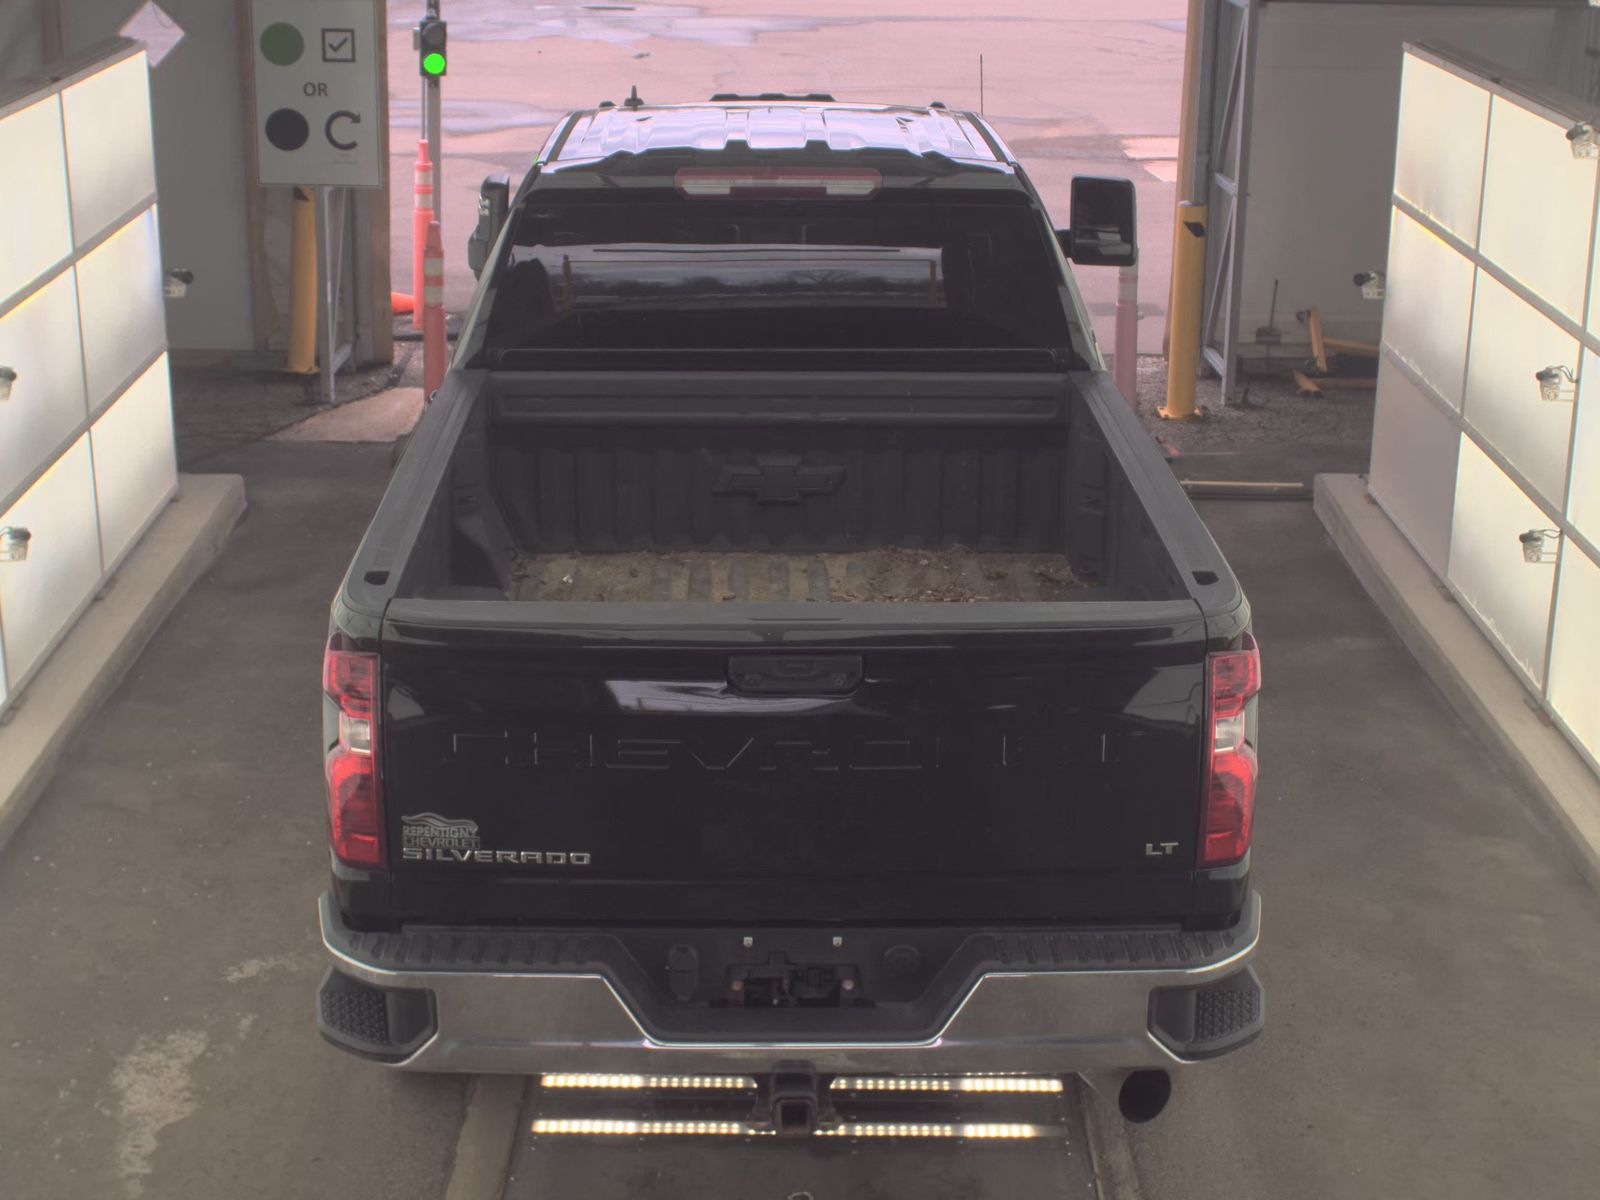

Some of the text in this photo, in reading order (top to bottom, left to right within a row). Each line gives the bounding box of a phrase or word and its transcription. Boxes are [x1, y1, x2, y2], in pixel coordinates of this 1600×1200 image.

[303, 82, 328, 97] OR
[440, 730, 1132, 770] CHEVRO
[402, 825, 479, 838] REPENTIGNY
[402, 848, 591, 865] SILVERADO
[1145, 842, 1179, 856] LT
